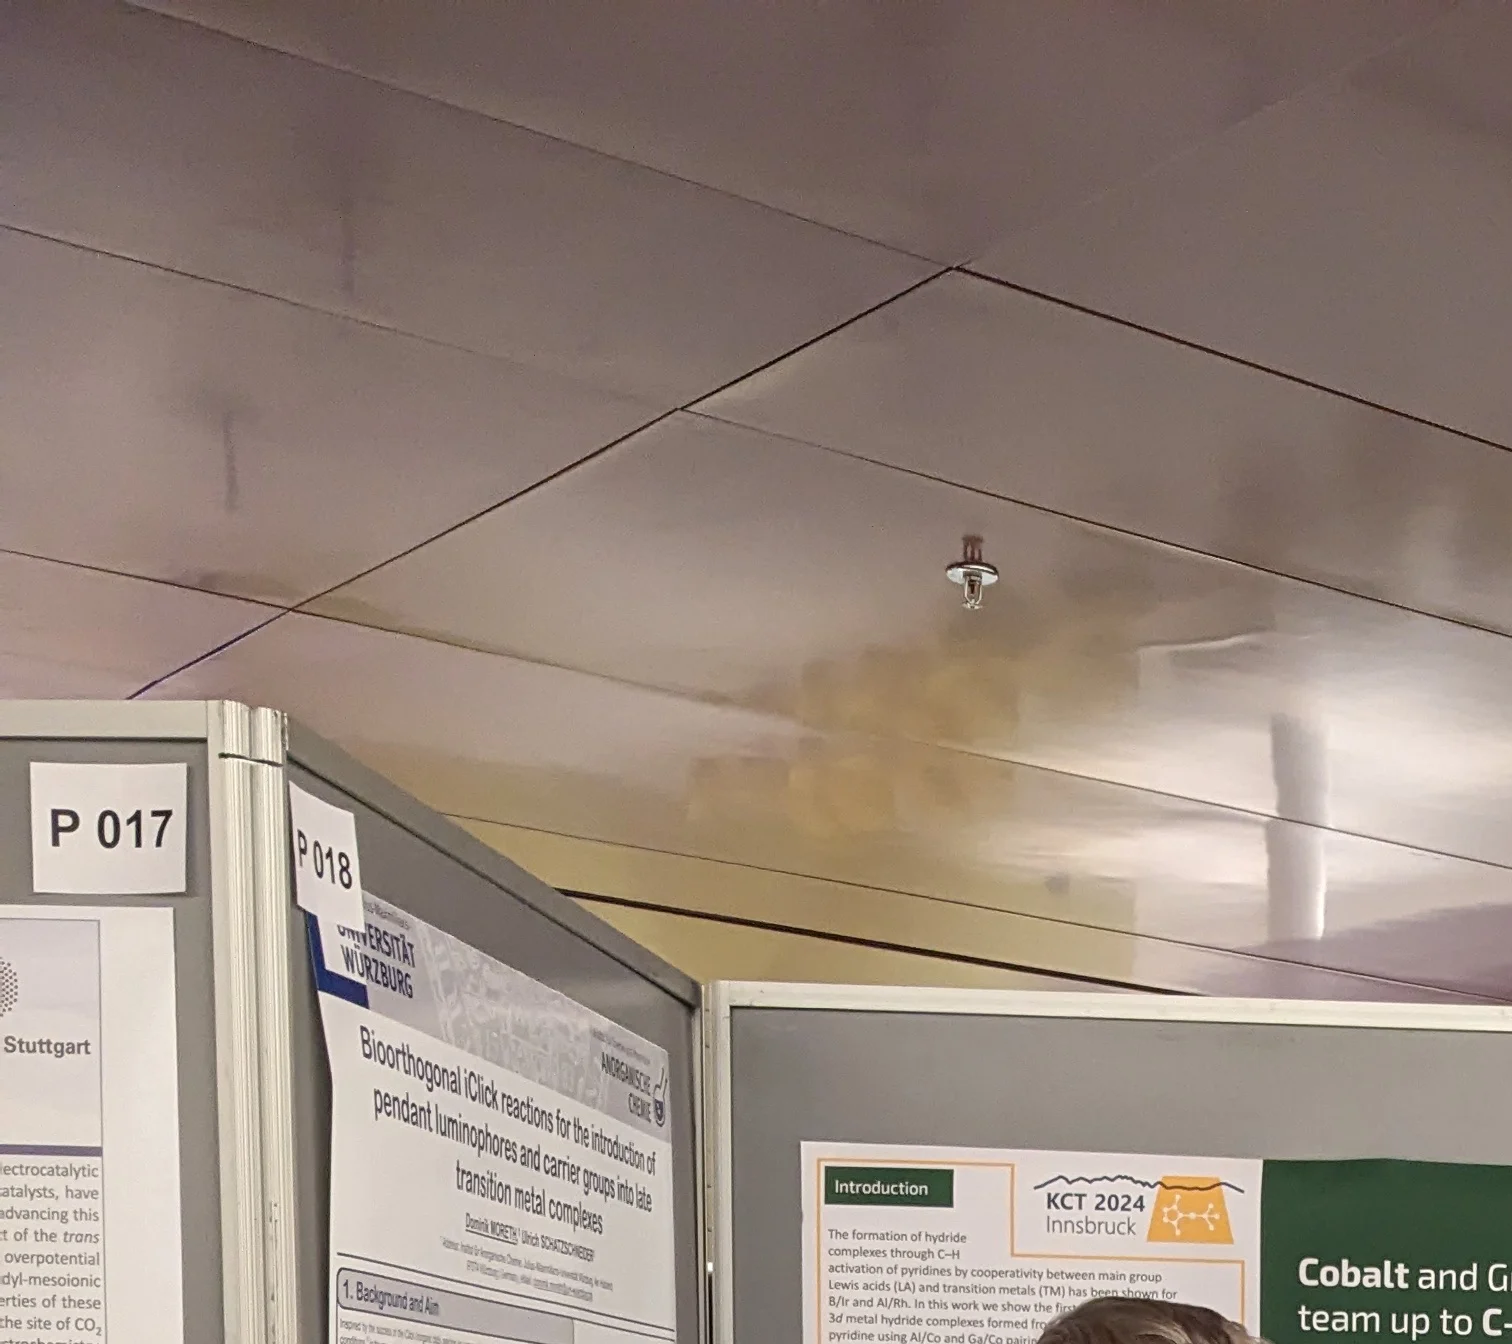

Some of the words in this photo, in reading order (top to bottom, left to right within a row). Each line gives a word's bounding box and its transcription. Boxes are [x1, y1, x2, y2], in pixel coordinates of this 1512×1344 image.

[50, 808, 81, 847] P
[97, 809, 173, 849] 017
[297, 829, 308, 869] P
[312, 839, 353, 889] 018
[340, 944, 414, 999] WÜRZBURG
[3, 1035, 92, 1059] Stuttgart
[359, 1025, 461, 1094] Bioorthogonal
[464, 1069, 499, 1112] iClick
[501, 1091, 554, 1133] reactions
[555, 1108, 572, 1139] for
[573, 1117, 590, 1149] the
[591, 1123, 645, 1171] introduction
[646, 1151, 657, 1177] of
[373, 1087, 433, 1133] pendant
[435, 1103, 518, 1164] luminophores
[520, 1142, 542, 1173] and
[543, 1149, 581, 1186] carrier
[582, 1165, 616, 1201] groups
[616, 1175, 635, 1204] into
[636, 1181, 653, 1213] late
[65, 1184, 100, 1200] have
[456, 1160, 512, 1207] transition
[514, 1182, 546, 1217] metal
[548, 1197, 604, 1236] complexes
[835, 1179, 929, 1196] Introduction
[1046, 1192, 1087, 1210] KCT
[1094, 1194, 1146, 1212] 2024
[73, 1207, 100, 1222] this
[13, 1228, 29, 1242] of
[34, 1228, 58, 1243] the
[63, 1231, 100, 1244] trans
[1046, 1215, 1137, 1236] Innsbruck
[828, 1229, 849, 1240] The
[852, 1229, 908, 1242] formation
[910, 1231, 922, 1242] of
[925, 1231, 967, 1244] hydride
[4, 1252, 100, 1268] overpotential
[828, 1245, 887, 1259] complexes
[890, 1247, 934, 1261] through
[828, 1263, 883, 1275] activation
[886, 1264, 899, 1275] of
[901, 1264, 952, 1278] pyridines
[955, 1266, 968, 1279] by
[971, 1268, 1044, 1281] cooperativity
[1046, 1269, 1095, 1281] between
[1098, 1271, 1127, 1282] main
[1129, 1273, 1162, 1285] group
[1298, 1258, 1409, 1290] Cobalt
[1418, 1262, 1478, 1292] and
[42, 1294, 57, 1308] of
[62, 1295, 102, 1310] these
[343, 1279, 354, 1300] 1.
[356, 1285, 407, 1311] Background
[408, 1293, 424, 1313] and
[424, 1295, 440, 1317] Aim
[26, 1316, 52, 1330] site
[56, 1316, 71, 1331] of
[1298, 1304, 1380, 1333] team
[1391, 1311, 1431, 1341] up
[1440, 1307, 1473, 1337] to
